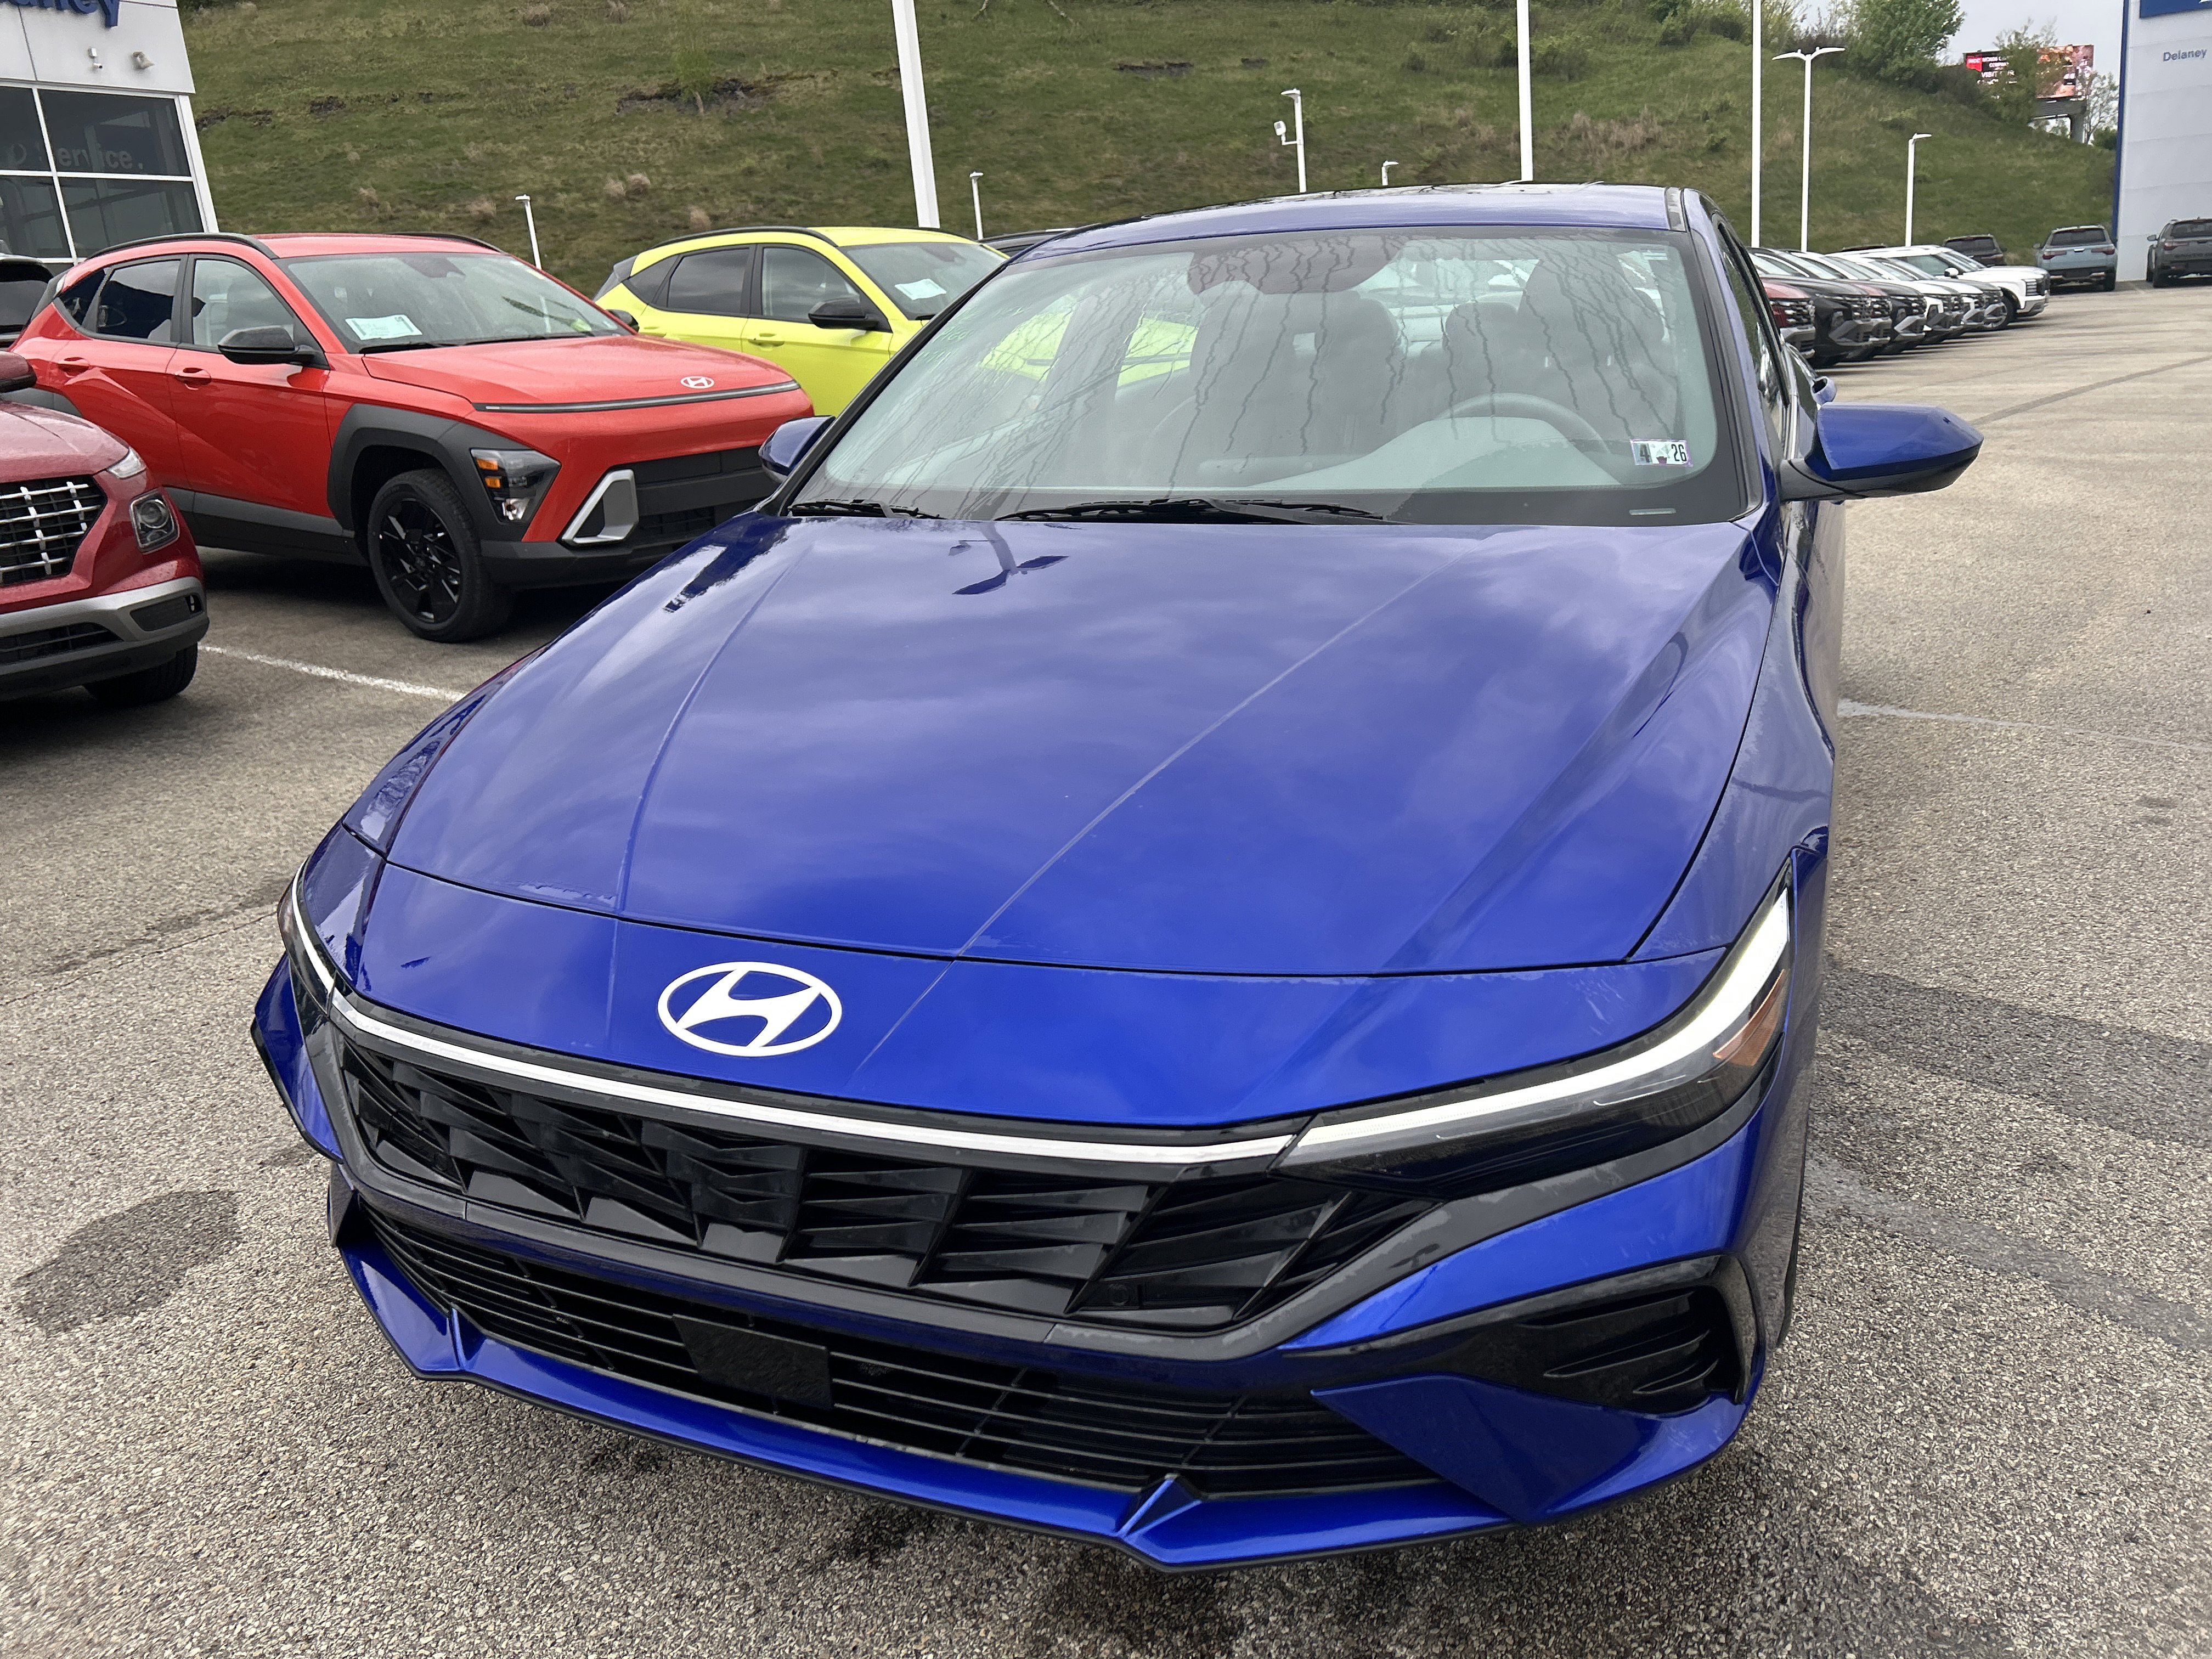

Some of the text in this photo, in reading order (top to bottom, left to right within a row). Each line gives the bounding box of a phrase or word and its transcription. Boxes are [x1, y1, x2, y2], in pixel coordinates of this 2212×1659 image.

[2163, 49, 2208, 61] Delaney
[35, 143, 143, 170] ervice.
[1640, 444, 1688, 463] 4 26
